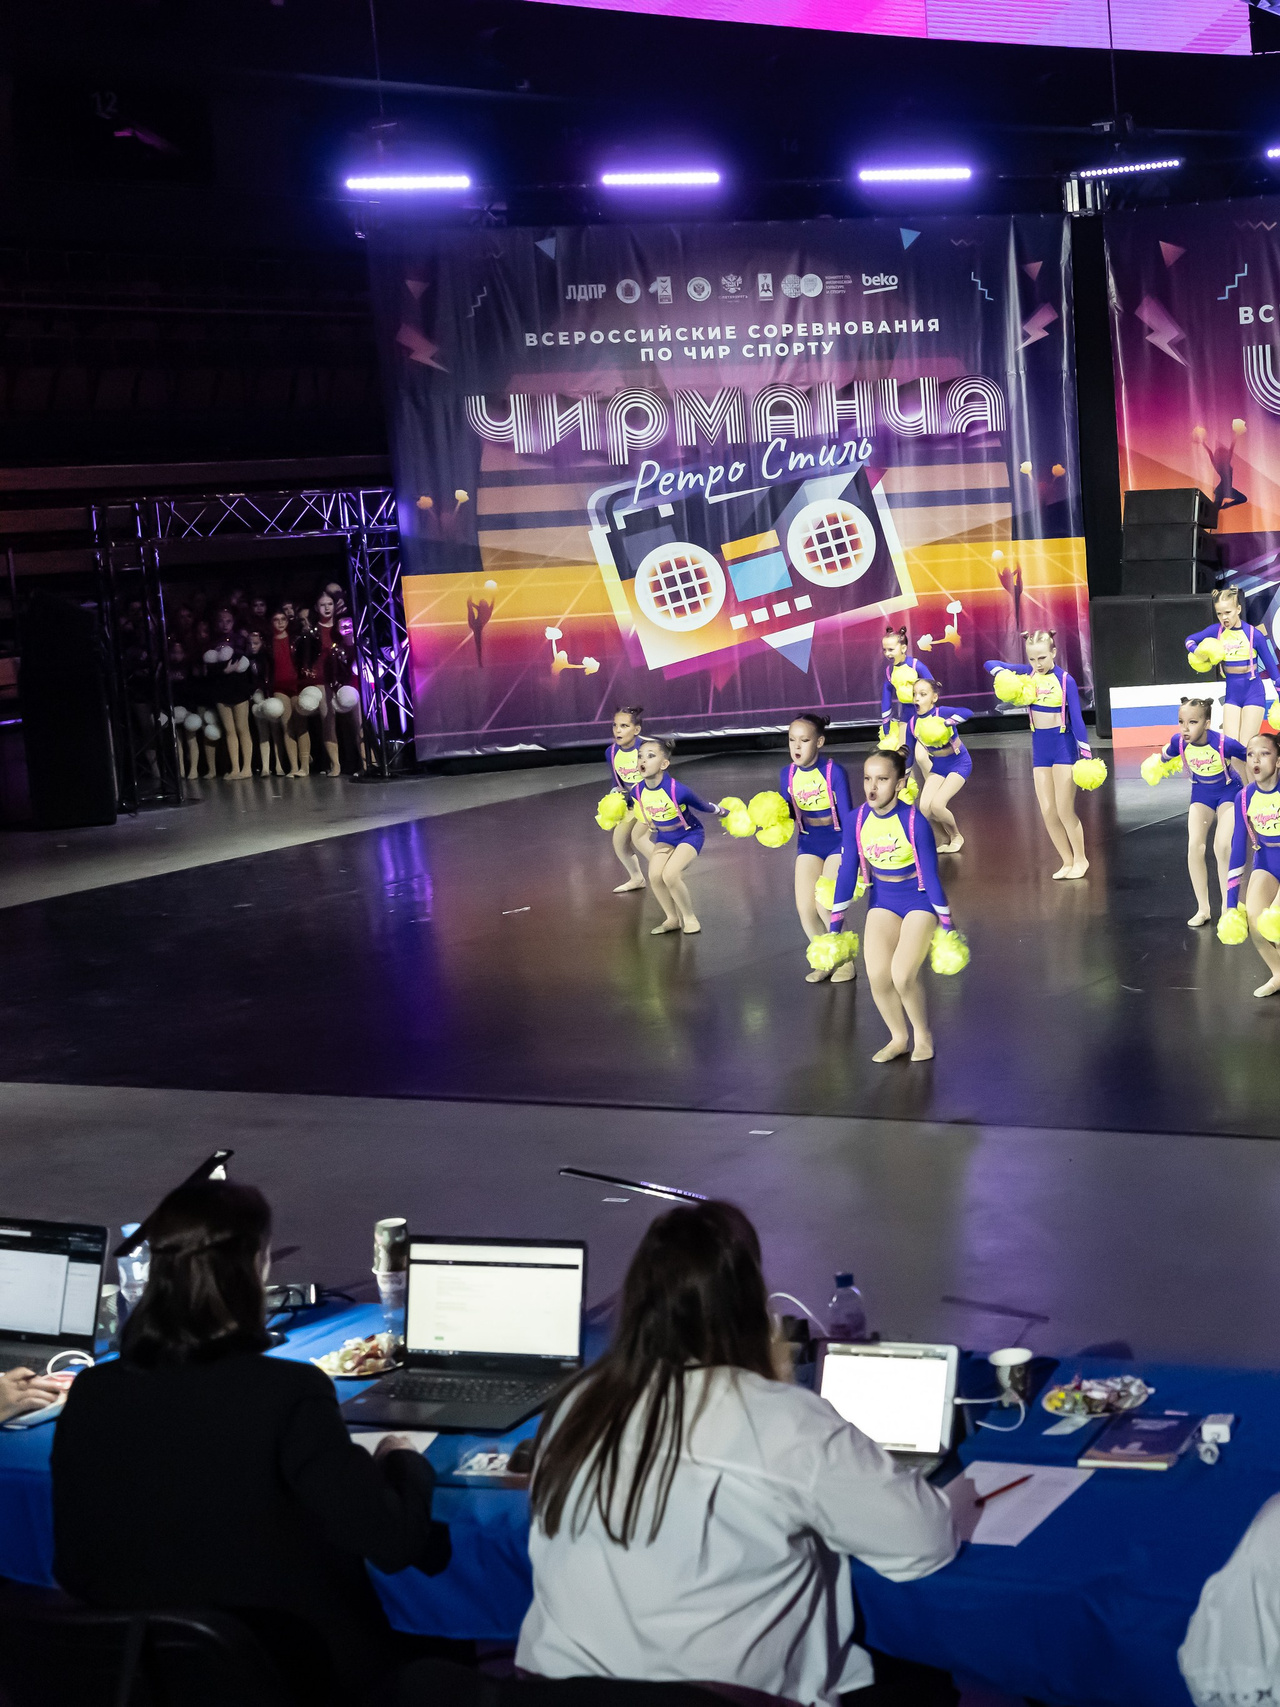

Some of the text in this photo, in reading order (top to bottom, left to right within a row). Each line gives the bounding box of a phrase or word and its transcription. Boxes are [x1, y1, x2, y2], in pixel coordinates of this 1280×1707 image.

[861, 272, 899, 287] beko
[565, 283, 607, 302] ЛДПР
[524, 318, 941, 347] ВСЕРОССИЙСКИЕ СОРЕВНОВАНИЯ
[640, 340, 836, 363] ПО ЧИР СПОРТУ
[632, 434, 873, 505] Ретро Стиль
